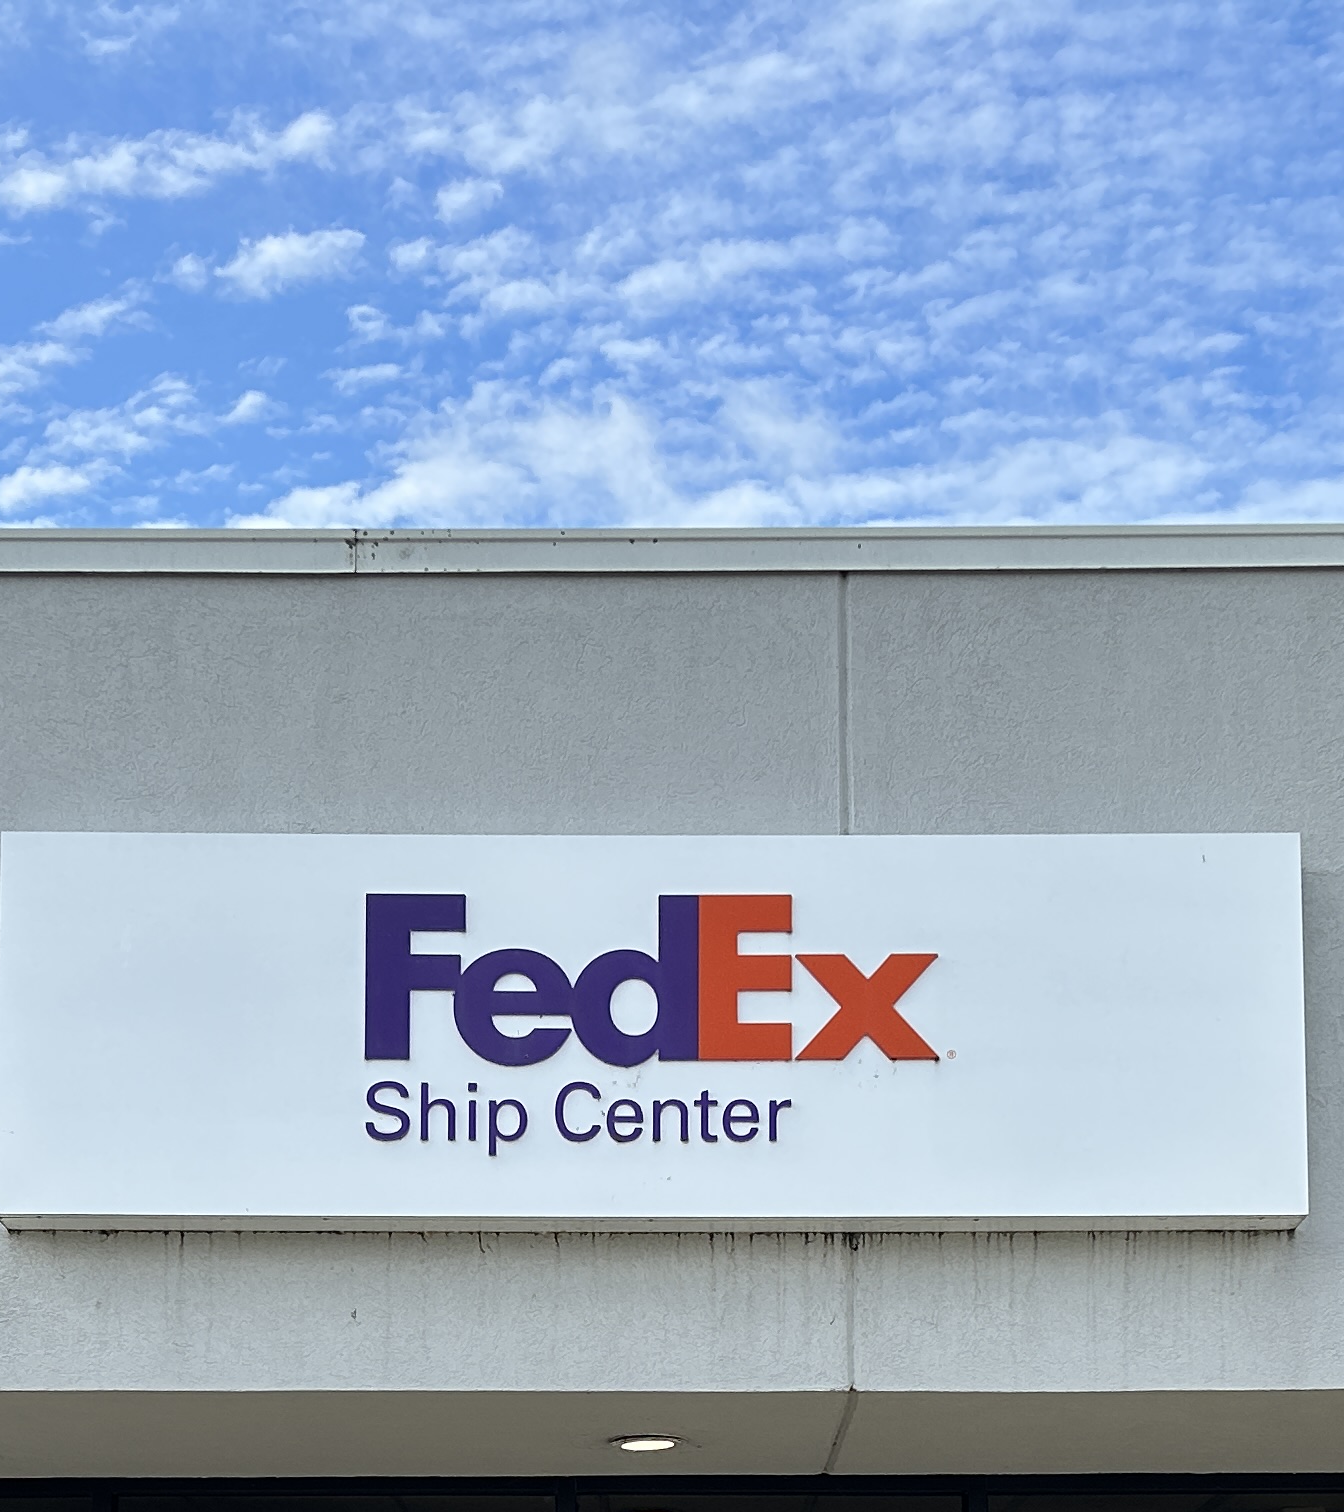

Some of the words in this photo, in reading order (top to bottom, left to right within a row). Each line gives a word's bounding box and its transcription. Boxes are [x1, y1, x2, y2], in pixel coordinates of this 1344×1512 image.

[365, 894, 939, 1067] FedEx
[365, 1081, 528, 1156] Ship
[555, 1081, 792, 1143] Center
